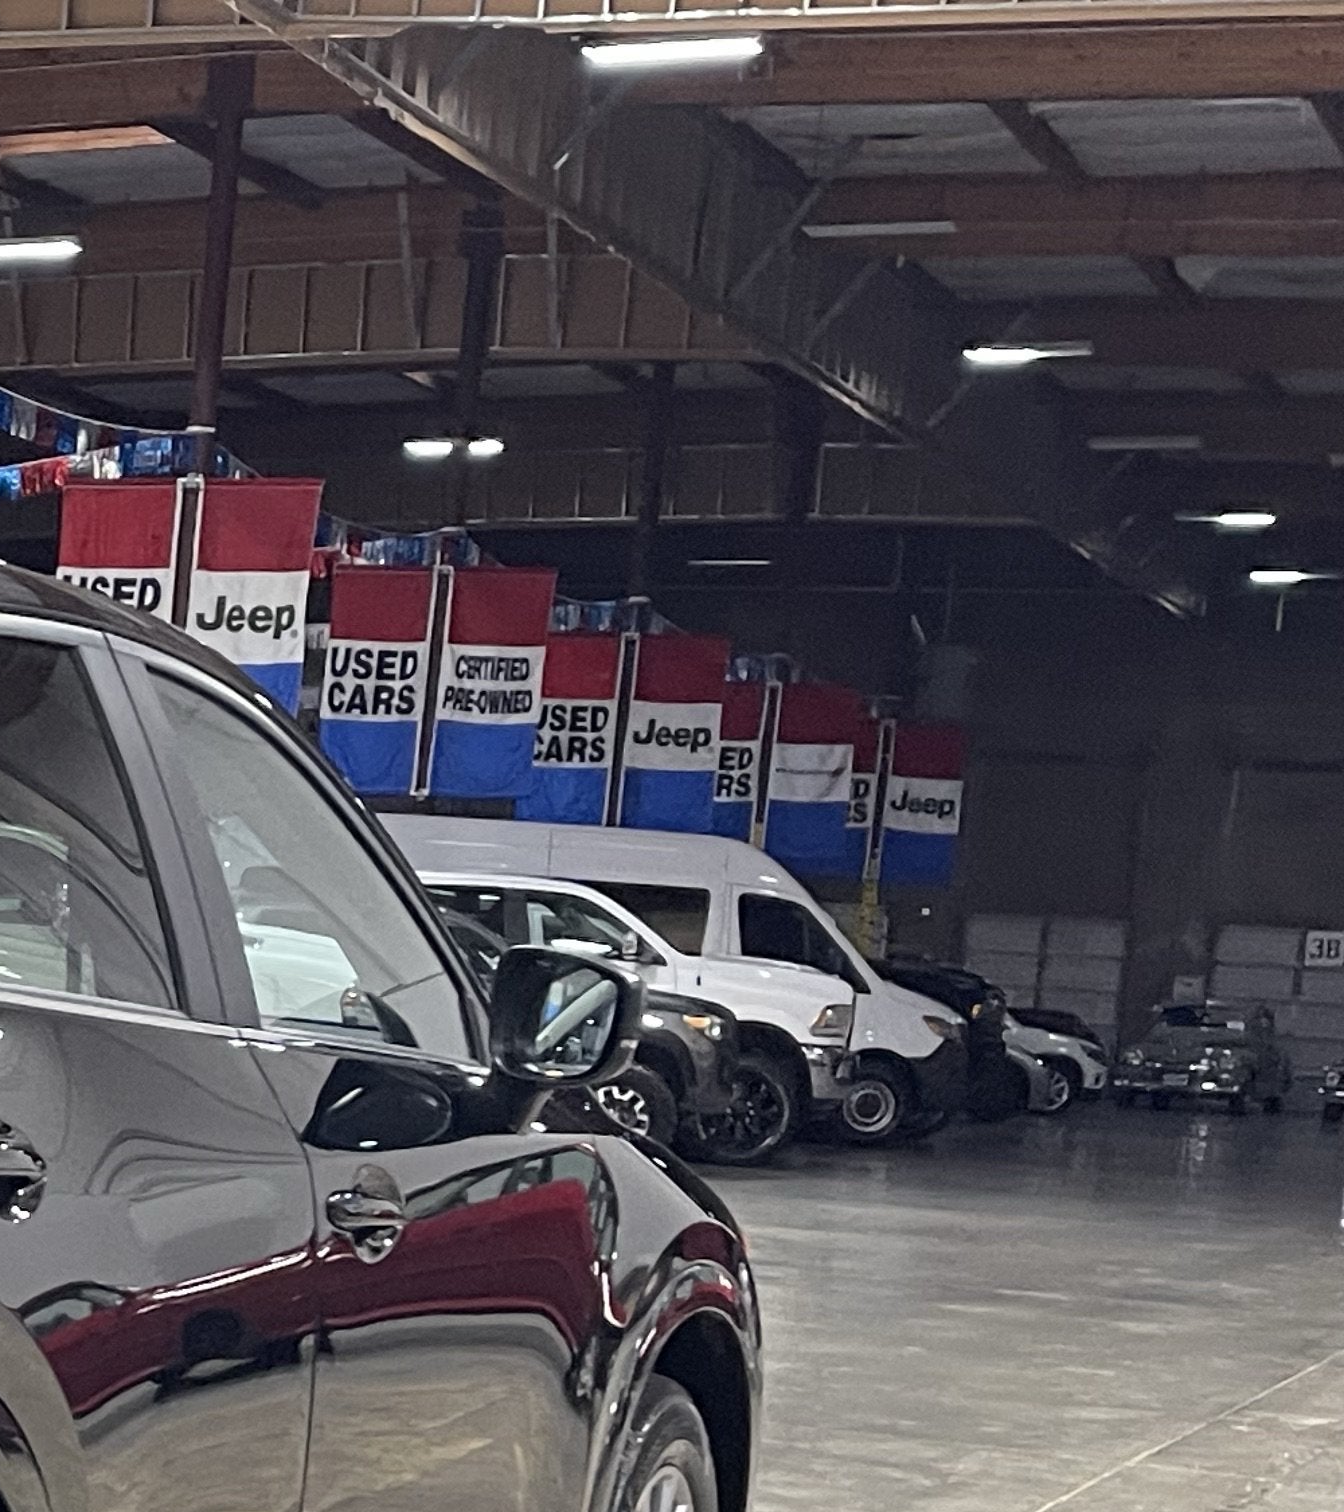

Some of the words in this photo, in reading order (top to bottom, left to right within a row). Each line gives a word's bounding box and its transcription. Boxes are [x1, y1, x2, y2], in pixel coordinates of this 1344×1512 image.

[63, 574, 162, 613] SED
[196, 595, 296, 640] Jeep
[330, 646, 419, 681] USED
[455, 655, 530, 682] CERTIFIED
[327, 681, 416, 715] CARS
[632, 718, 712, 753] Jeep
[891, 790, 955, 819] Jeep
